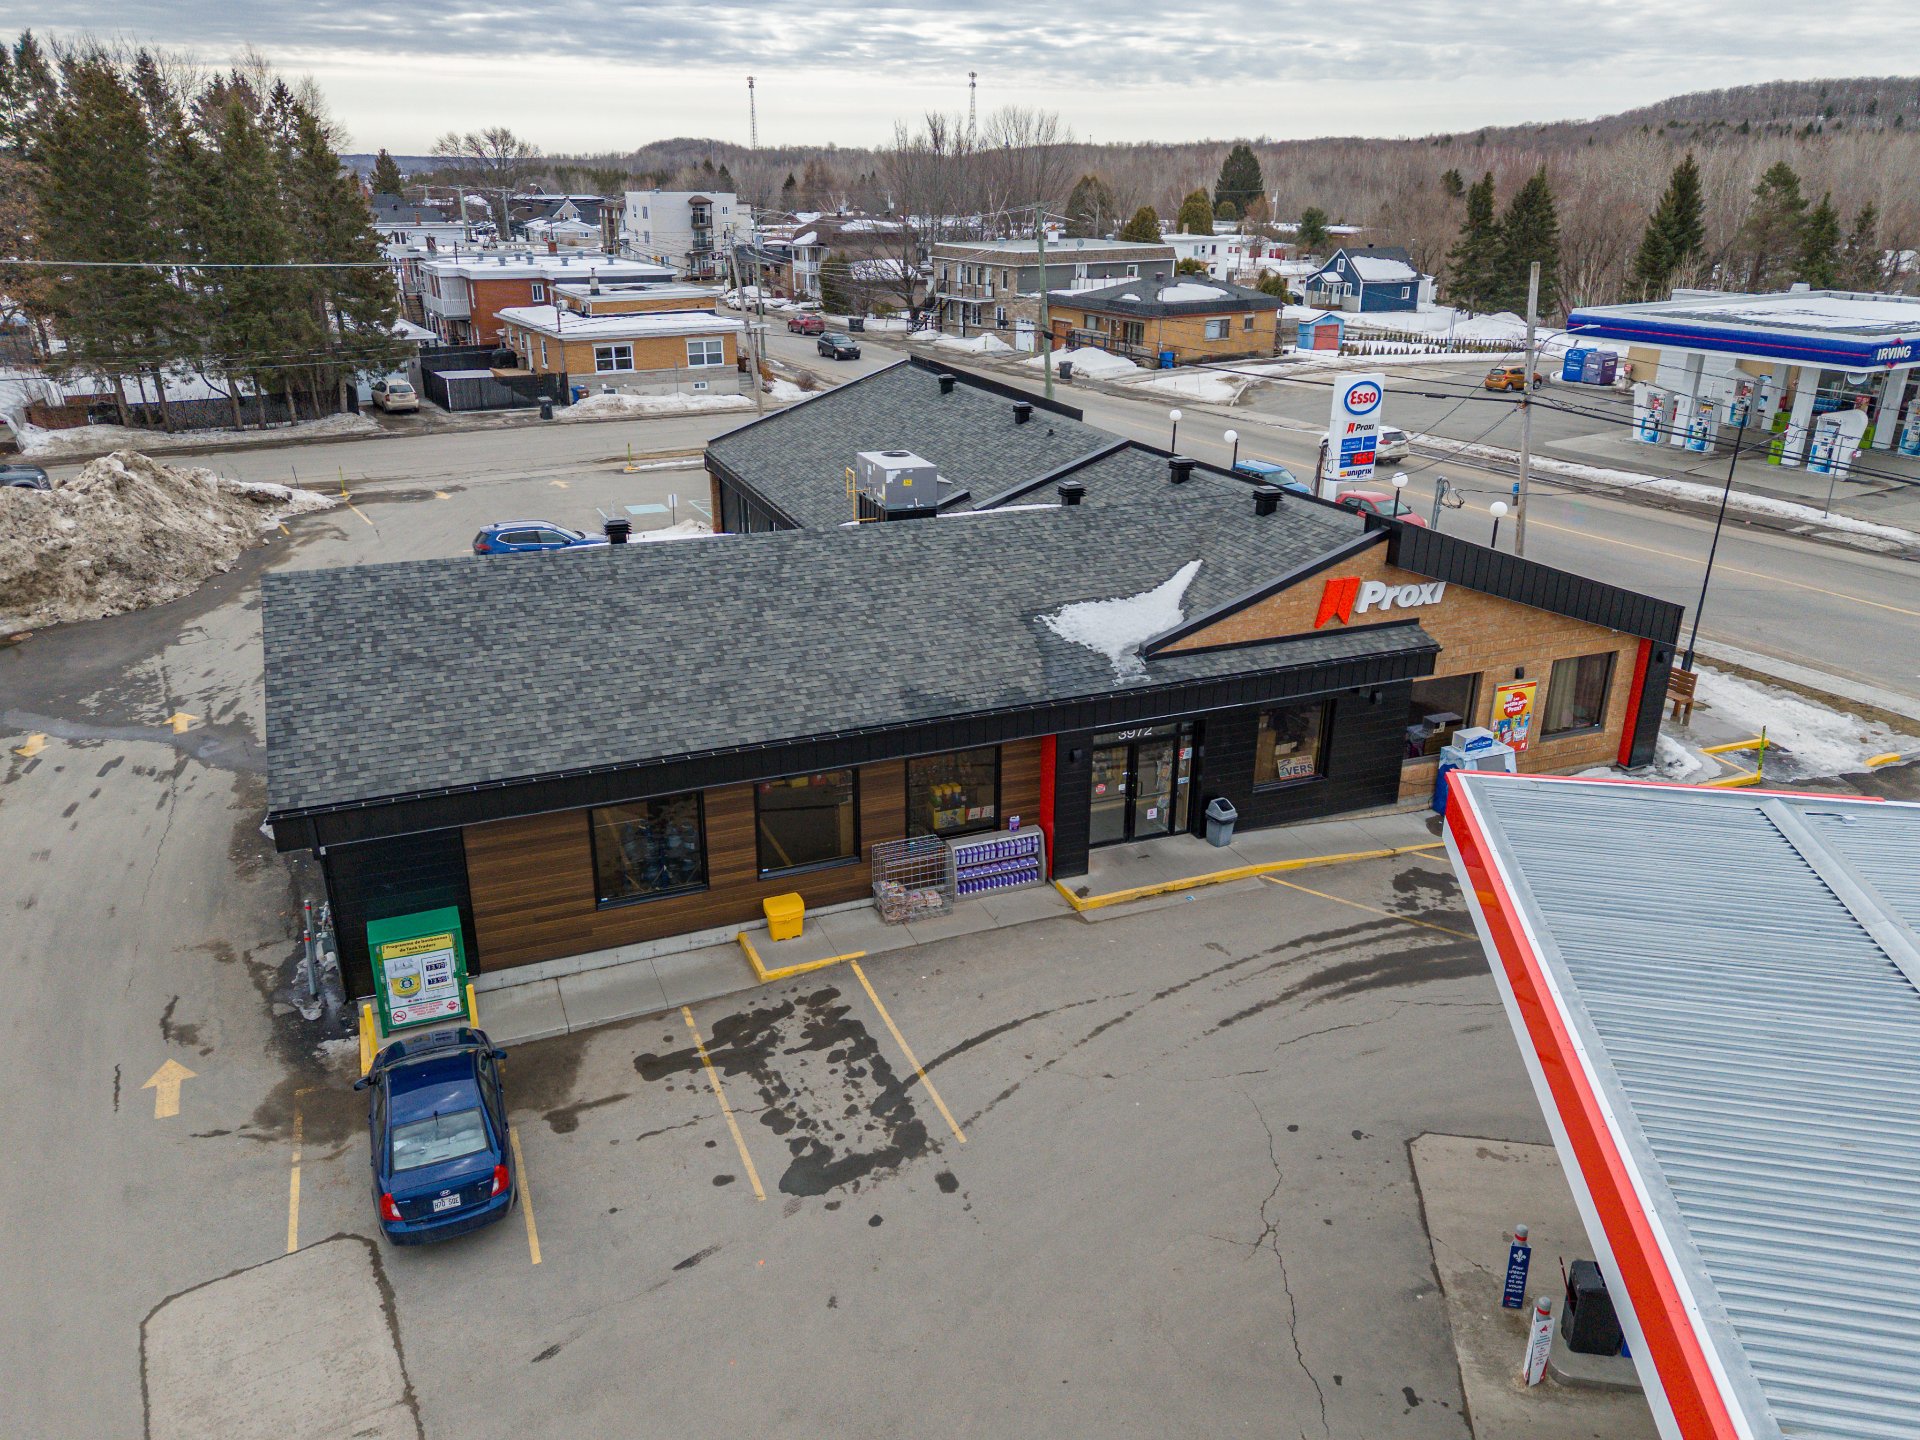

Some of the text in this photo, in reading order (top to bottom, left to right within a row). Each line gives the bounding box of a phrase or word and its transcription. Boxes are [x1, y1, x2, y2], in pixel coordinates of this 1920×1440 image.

[1877, 345, 1911, 361] IRVING
[1350, 390, 1376, 405] Esso
[1355, 423, 1374, 431] Proxi
[1347, 468, 1372, 478] uniprix
[1354, 580, 1447, 613] Proxi
[386, 941, 414, 949] Programme
